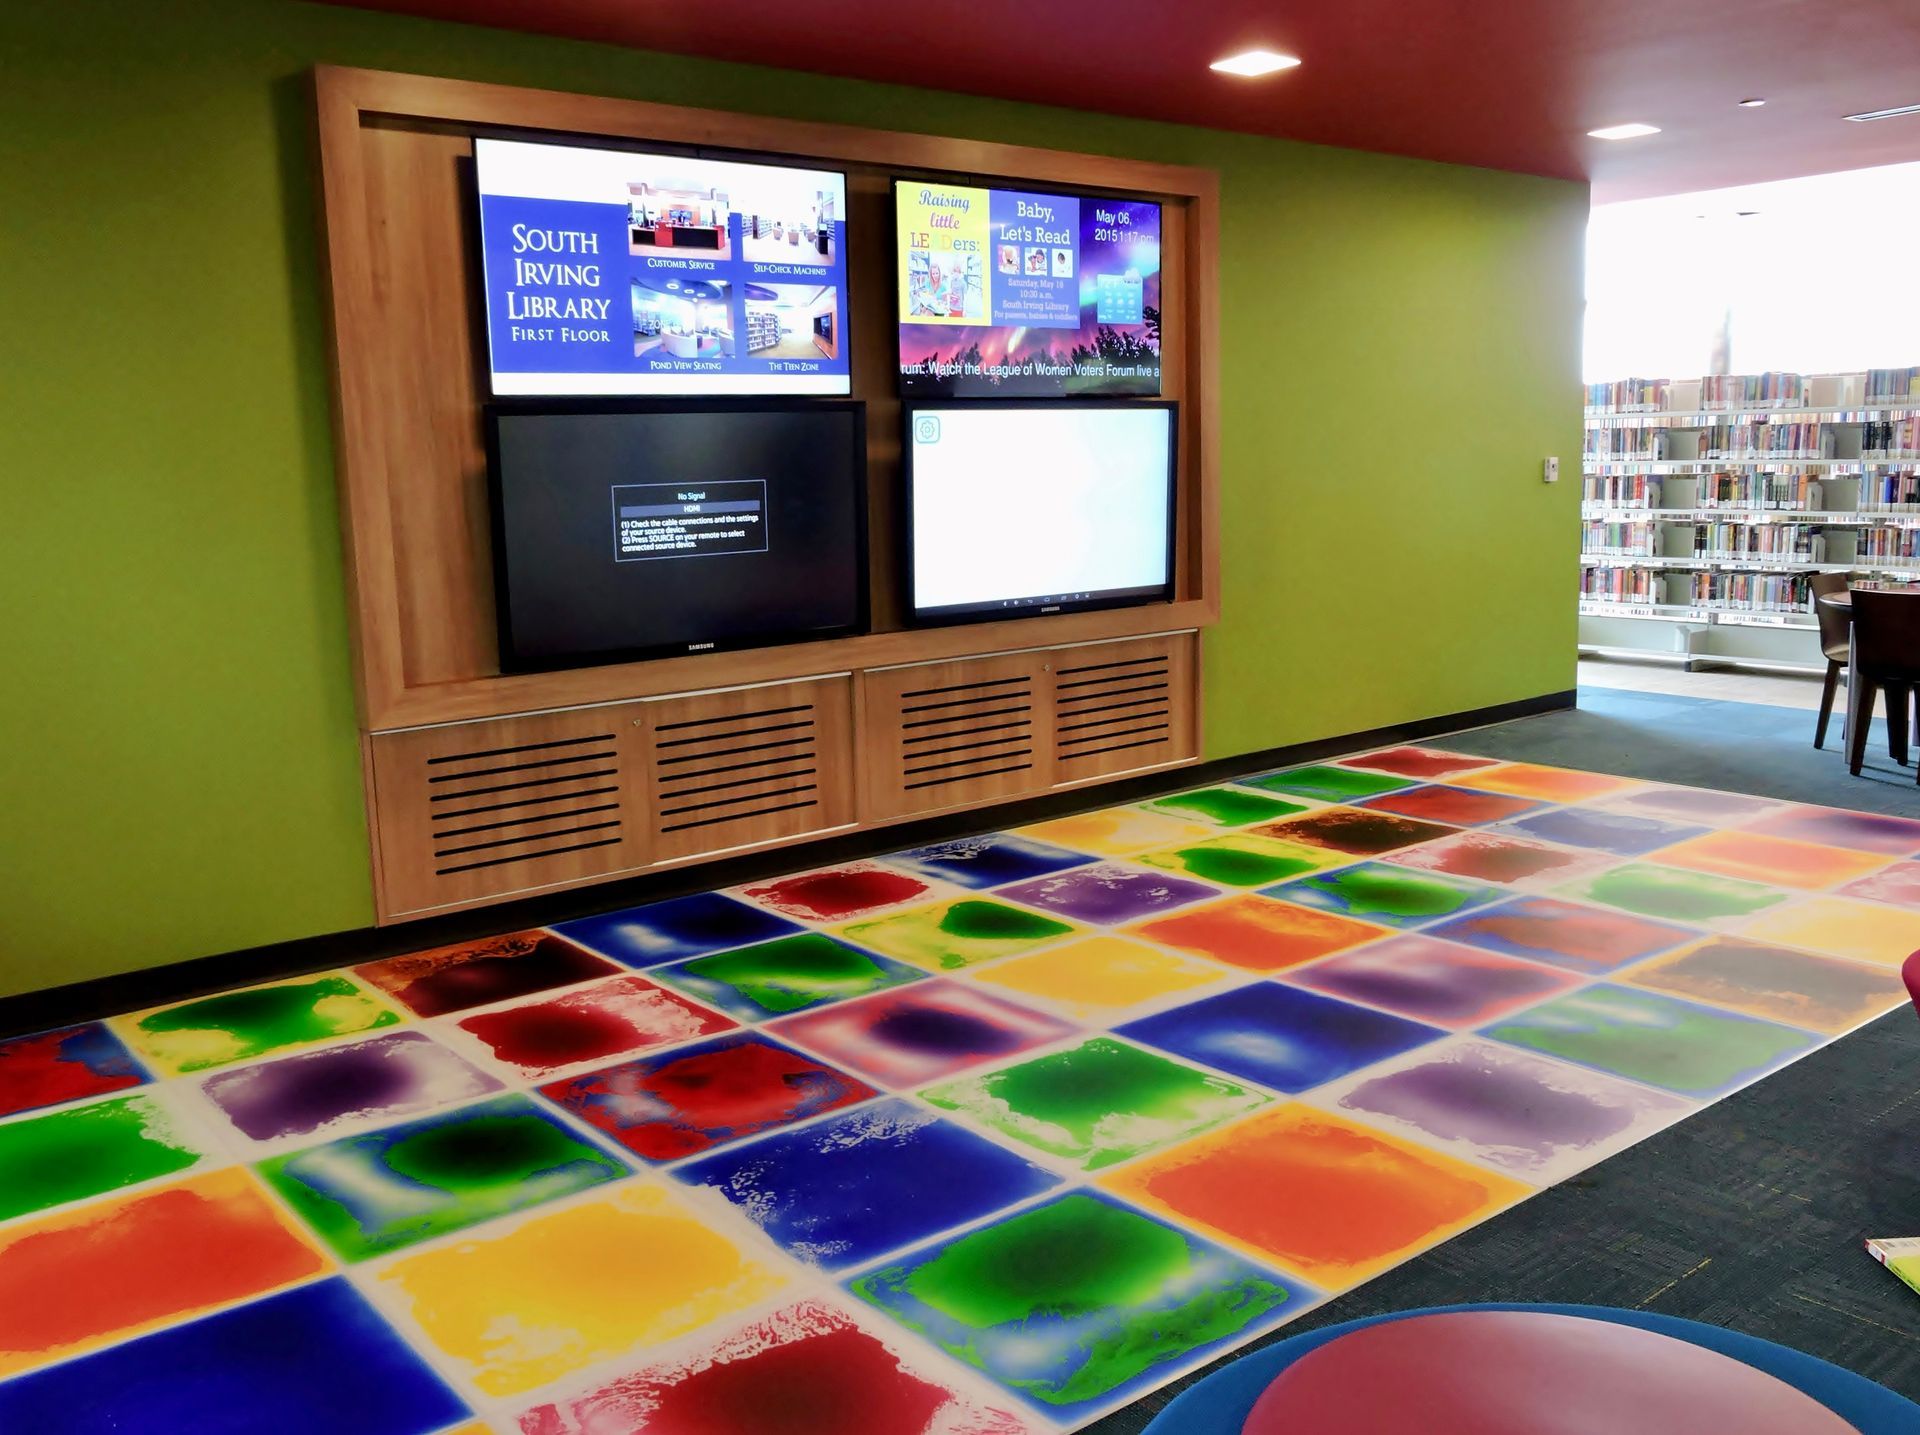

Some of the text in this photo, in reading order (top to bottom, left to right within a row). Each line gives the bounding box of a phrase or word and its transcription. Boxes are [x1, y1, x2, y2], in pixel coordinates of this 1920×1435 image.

[919, 189, 970, 214] Raising
[1017, 201, 1055, 224] Baby,
[1096, 209, 1132, 226] May 06,
[930, 212, 960, 230] little
[512, 223, 599, 254] SOUTH
[1000, 223, 1071, 245] Let's Read
[1095, 228, 1118, 242] 2015
[647, 258, 715, 270] CUSTOMER SERVICE
[753, 263, 827, 276] SELF-CHECK MACHINES
[515, 258, 600, 287] IRVING
[506, 291, 611, 320] LIBRARY
[511, 326, 610, 342] FIRST FLOOR
[650, 361, 722, 370] POND VIEW SEATING
[768, 362, 819, 371] THE TEEN ZONE
[928, 361, 961, 376] Watch
[964, 362, 980, 375] the
[984, 363, 1021, 378] League
[1023, 363, 1032, 376] of
[1034, 363, 1071, 376] Women
[1074, 364, 1104, 376] Voters
[1106, 364, 1135, 376] Forum
[1136, 364, 1151, 376] live
[687, 491, 705, 501] Signal
[630, 520, 650, 528] Check
[650, 519, 661, 527] the
[661, 518, 678, 526] cable
[678, 516, 713, 525] connections
[714, 515, 725, 523] and
[725, 515, 736, 523] the
[736, 514, 759, 523] settings
[727, 530, 745, 538] select
